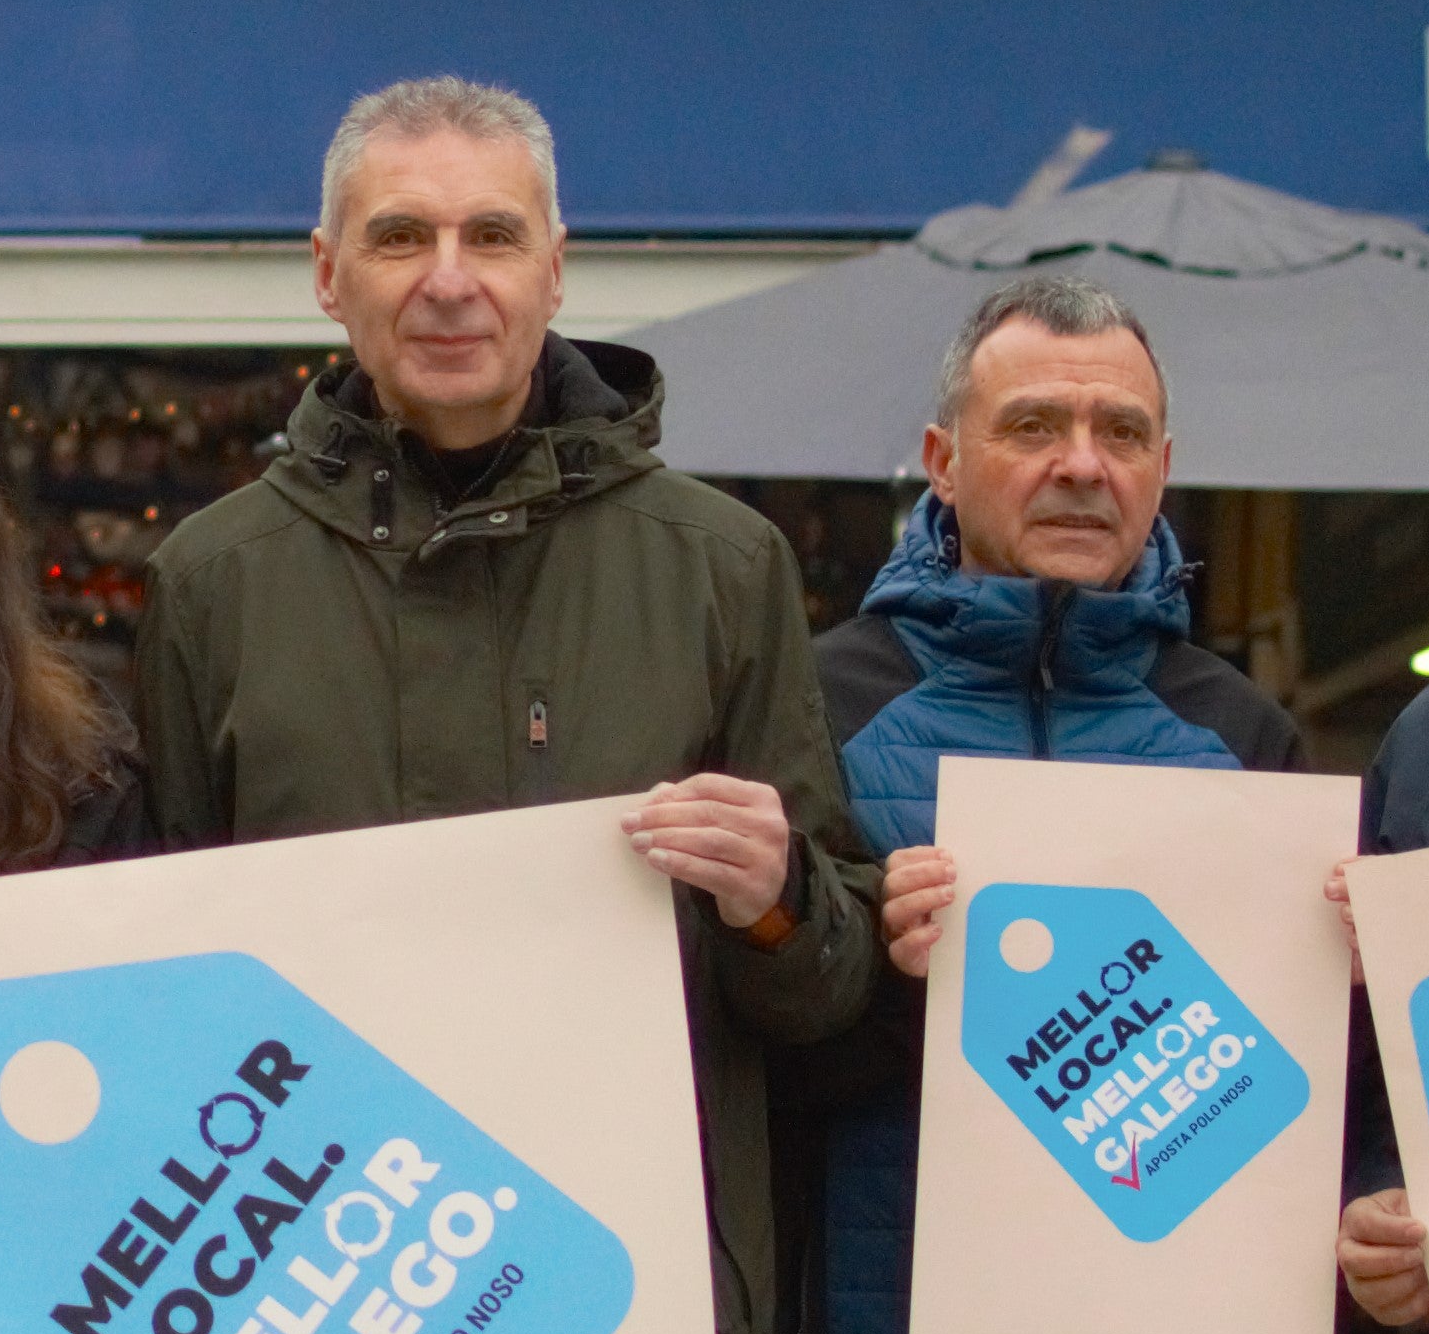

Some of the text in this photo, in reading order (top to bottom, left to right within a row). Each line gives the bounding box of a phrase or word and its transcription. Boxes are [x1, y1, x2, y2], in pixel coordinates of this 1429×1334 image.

[1005, 938, 1164, 1082] MELLOR
[1033, 997, 1174, 1114] LOCAL.
[1062, 1000, 1221, 1146] MELLOR
[1144, 1075, 1254, 1177] APOSTA POLO NOSO
[463, 1262, 526, 1333] NOSO
